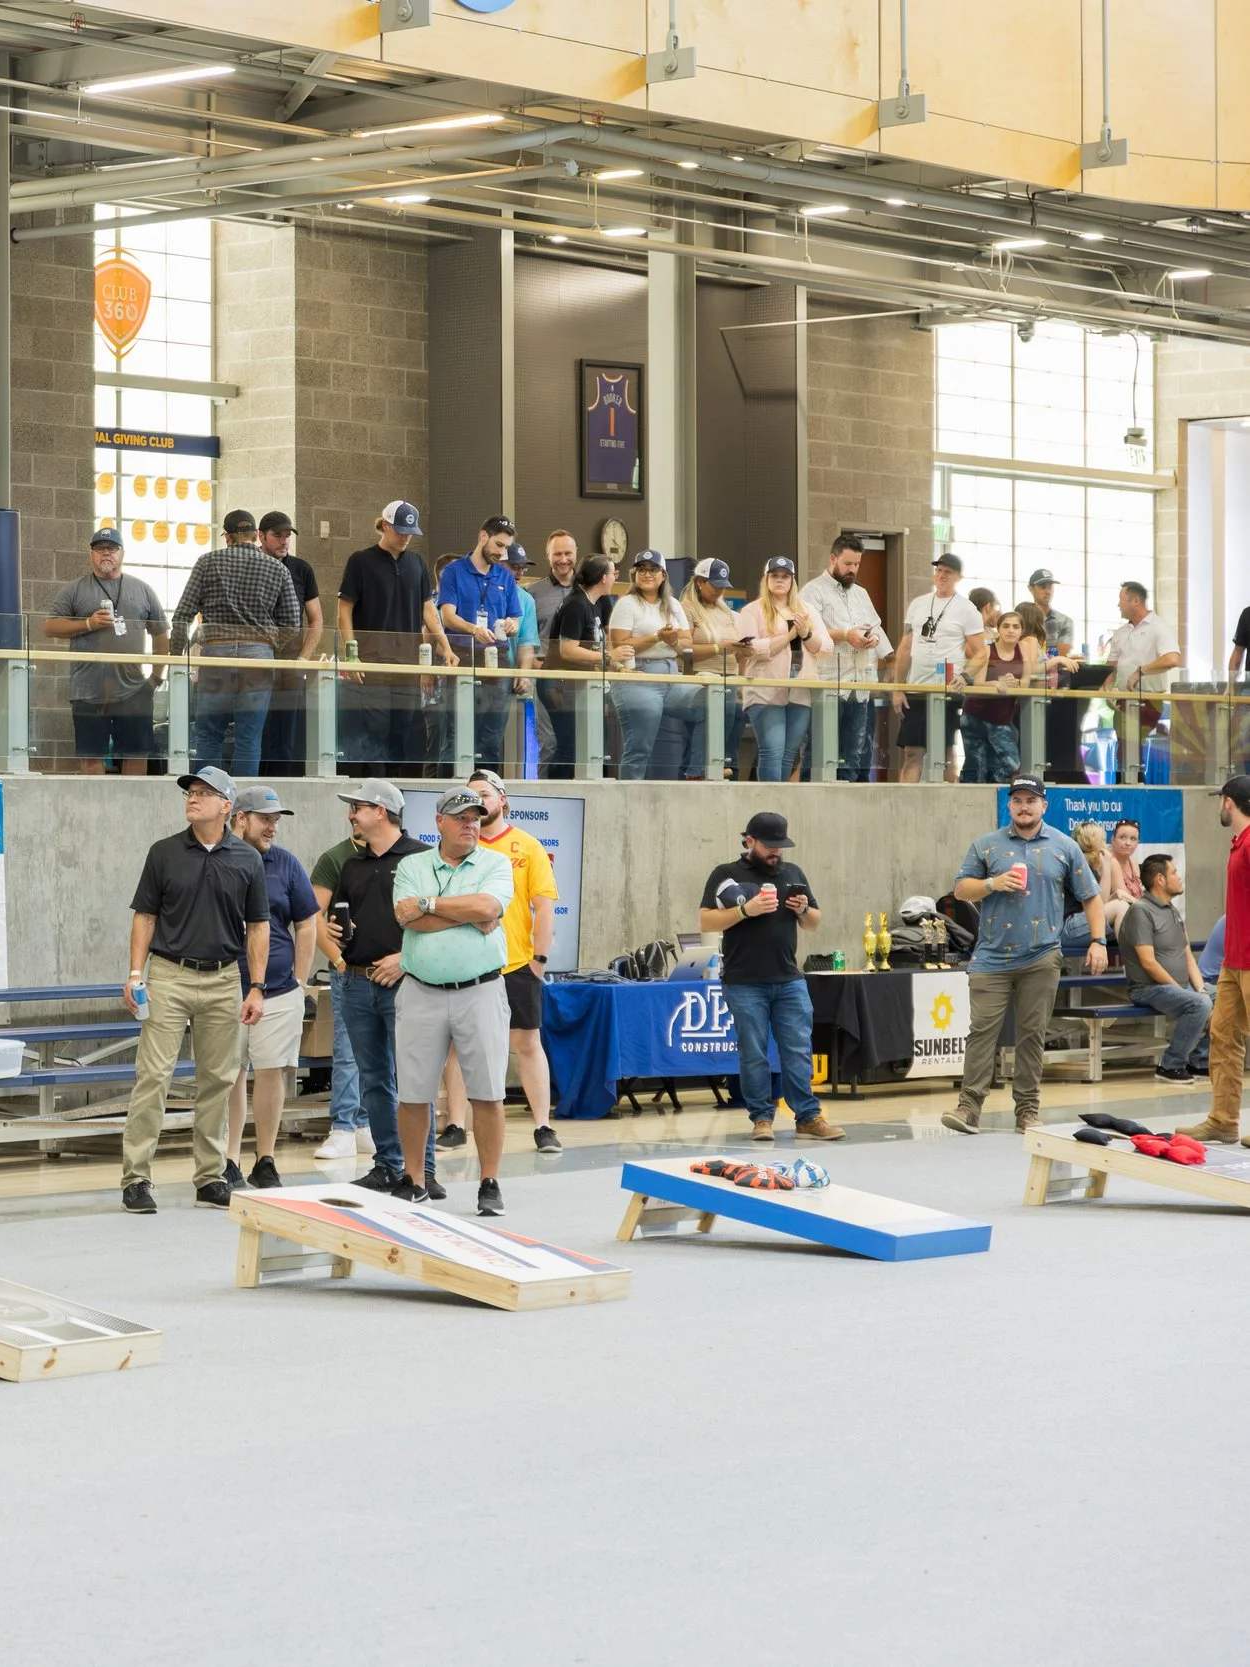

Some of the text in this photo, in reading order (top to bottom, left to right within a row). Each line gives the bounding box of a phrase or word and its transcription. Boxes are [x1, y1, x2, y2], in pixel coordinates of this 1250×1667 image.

[102, 284, 137, 301] CLUB
[610, 407, 615, 436] 1
[113, 433, 147, 447] GIVING
[149, 436, 175, 449] CLUB
[1065, 798, 1087, 812] Thank
[509, 810, 549, 822] SPONSORS
[419, 834, 436, 842] FOOD
[538, 838, 560, 847] NSORS
[681, 1041, 739, 1053] CONSTRUC
[921, 1056, 963, 1066] RENTALS
